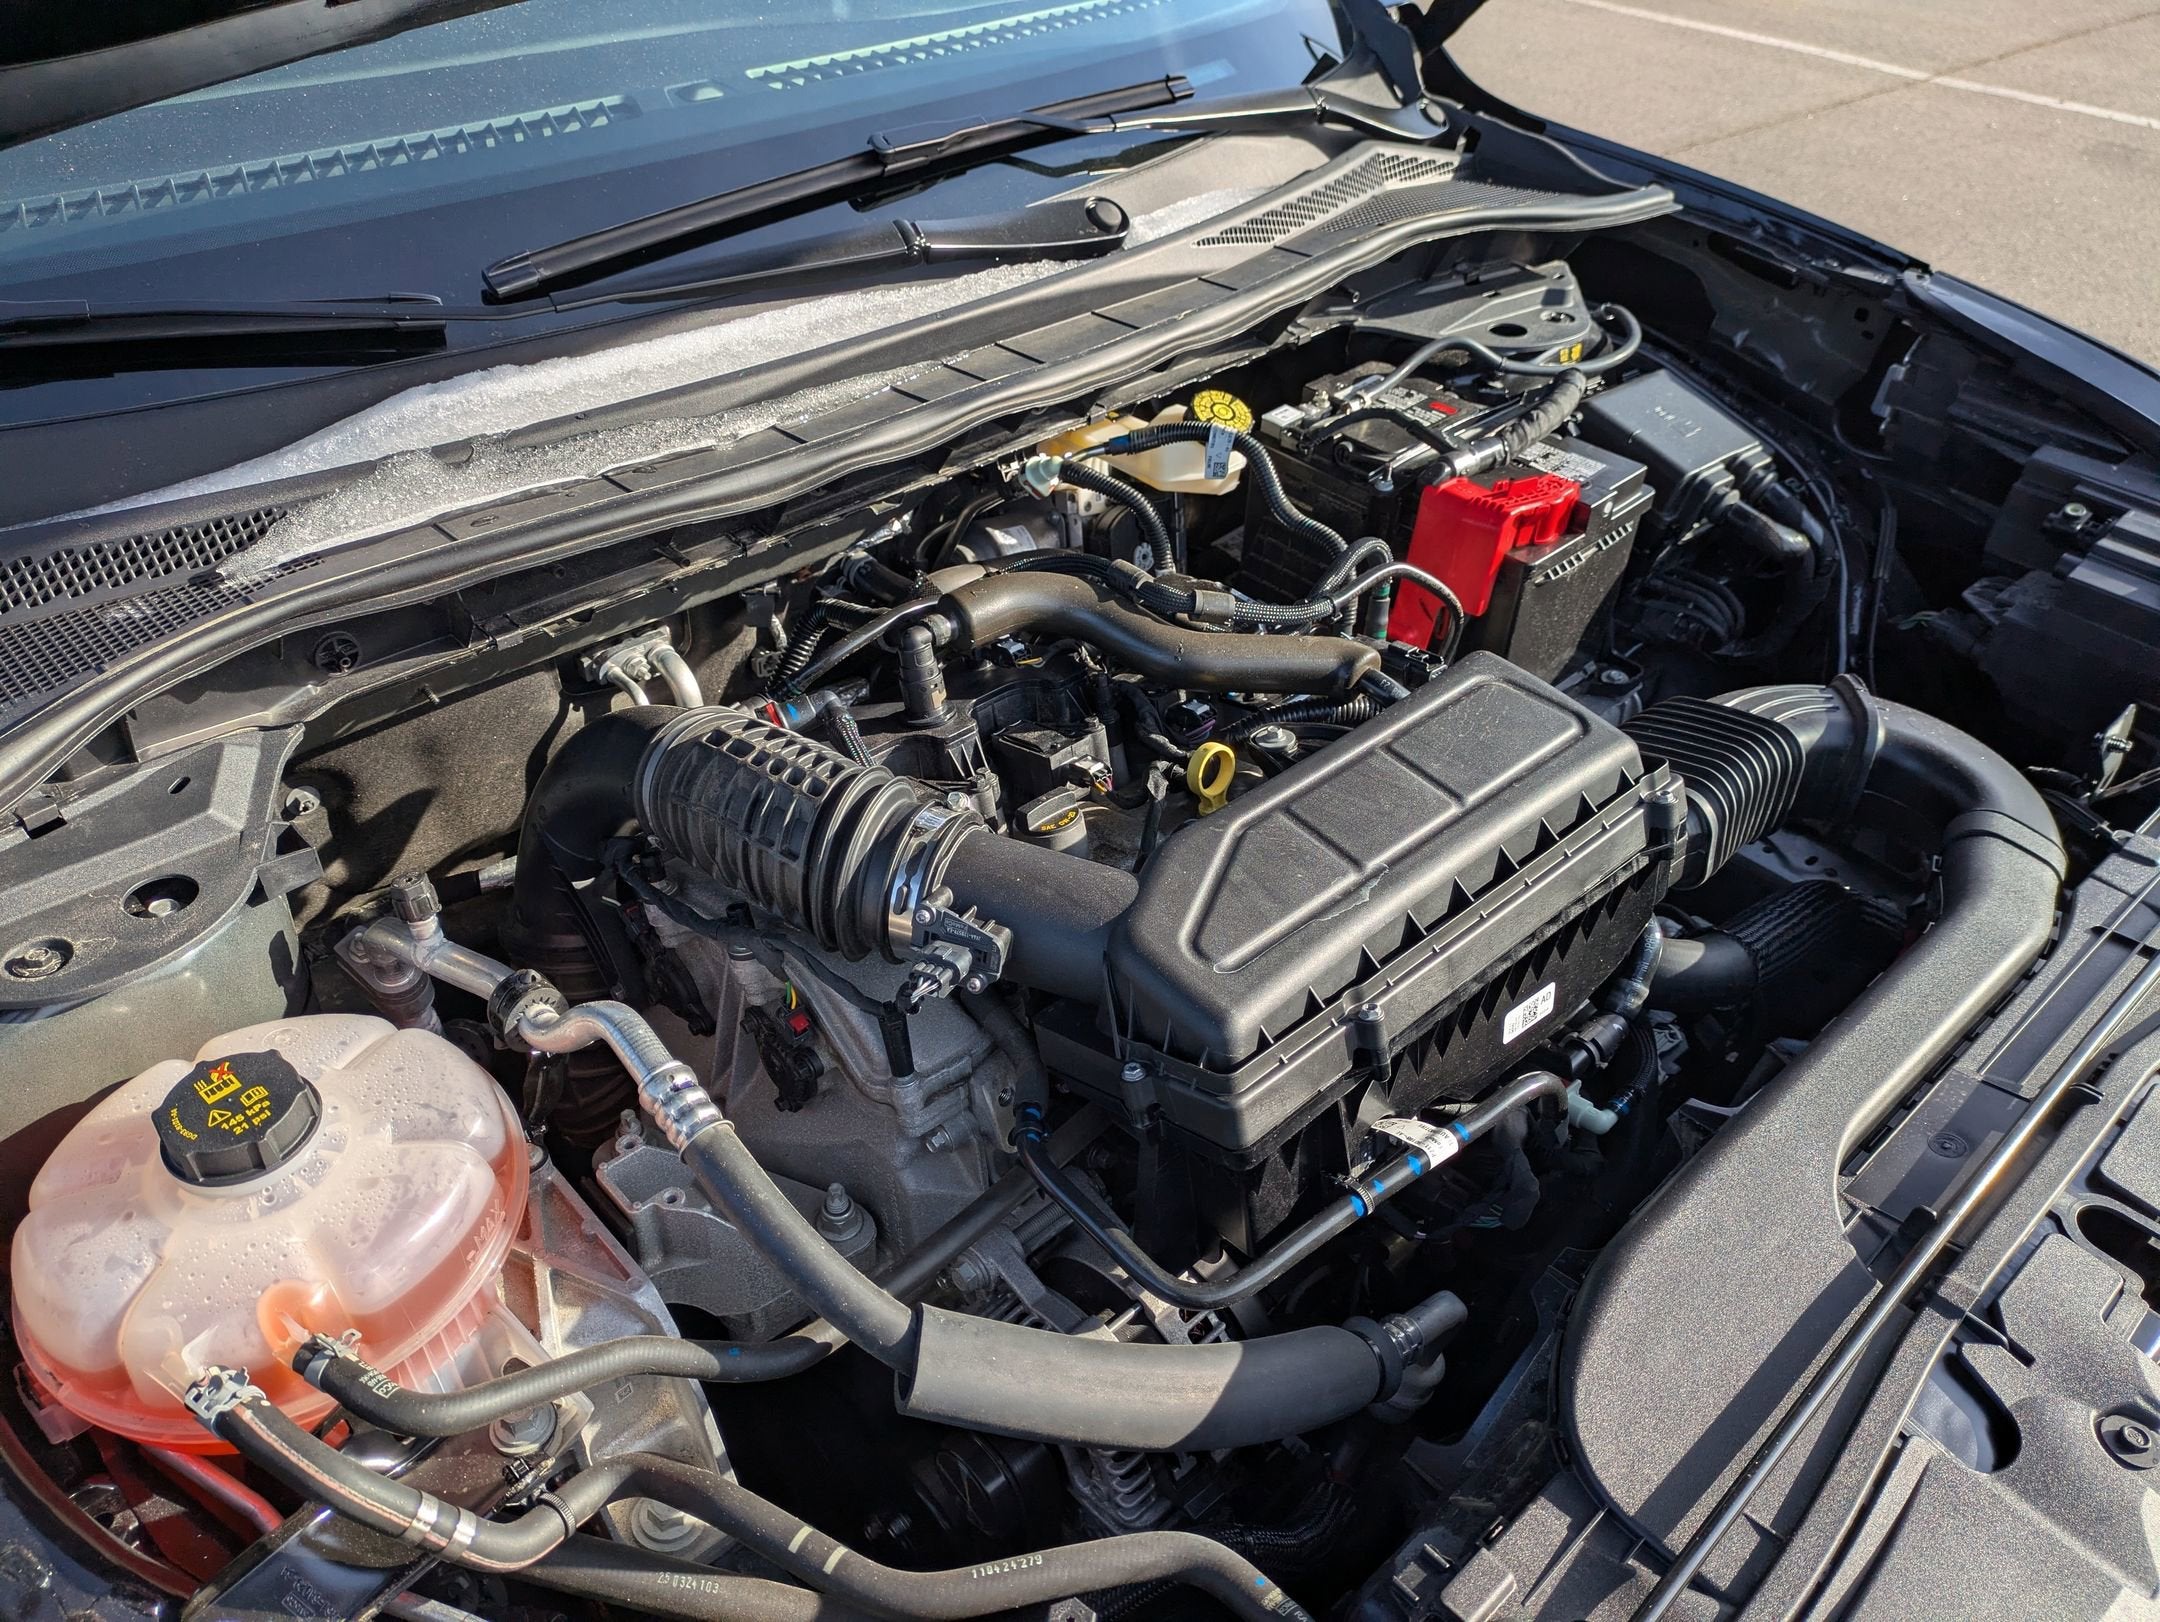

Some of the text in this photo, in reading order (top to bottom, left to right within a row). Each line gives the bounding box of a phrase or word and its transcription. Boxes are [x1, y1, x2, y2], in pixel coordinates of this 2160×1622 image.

[221, 1100, 271, 1130] 145 kPa
[233, 1109, 271, 1135] 21 psi
